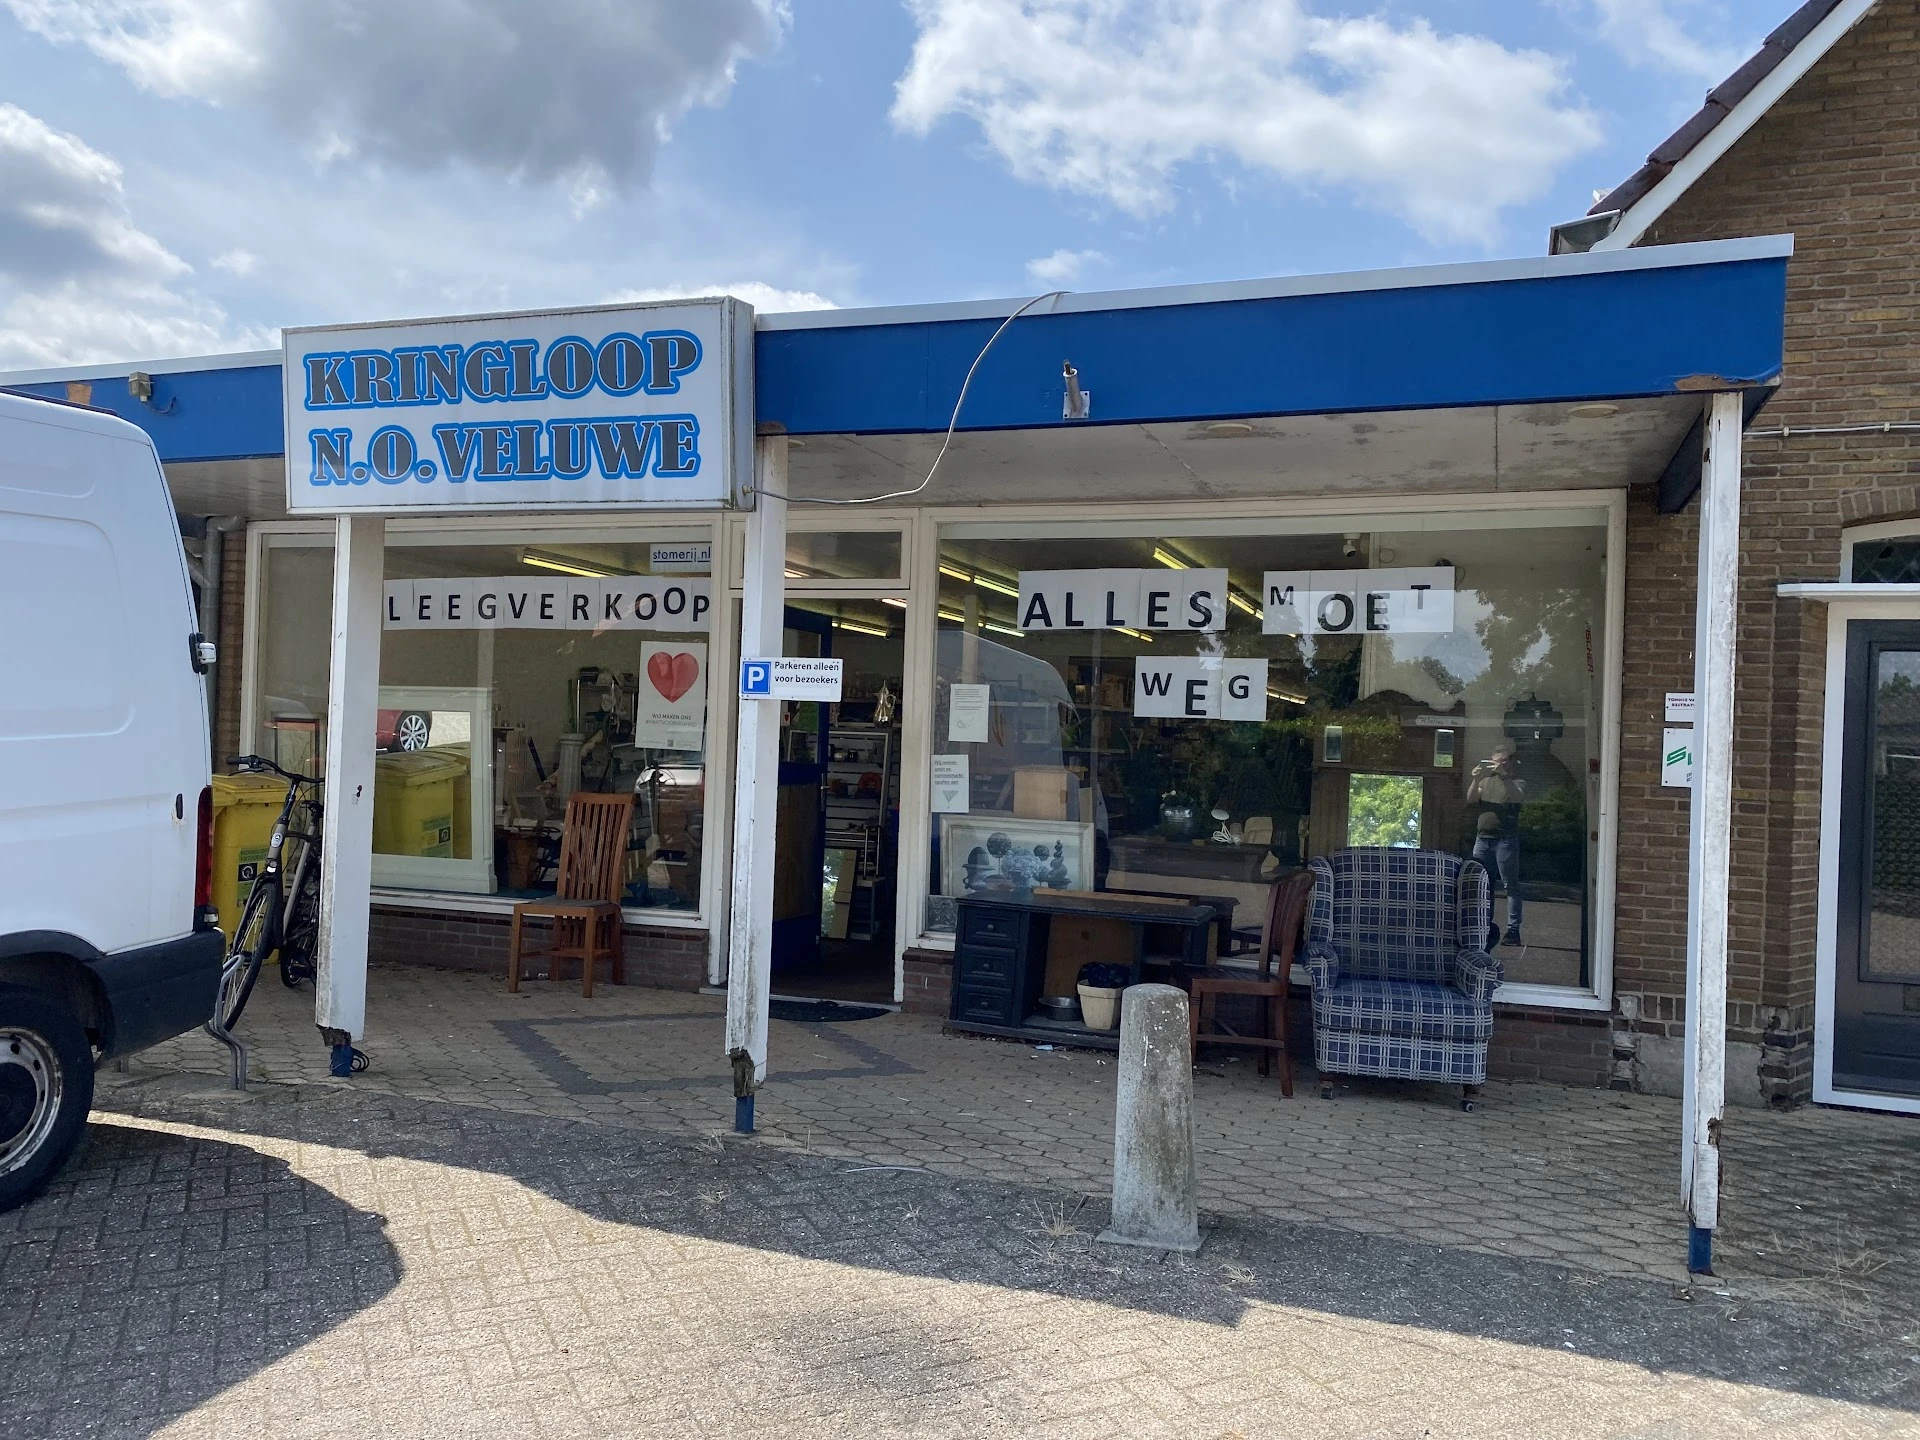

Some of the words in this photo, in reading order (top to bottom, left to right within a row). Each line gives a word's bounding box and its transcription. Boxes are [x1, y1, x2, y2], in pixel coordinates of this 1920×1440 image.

[304, 330, 702, 410] KRINGLOOP
[653, 546, 711, 563] stomerij.nl
[388, 587, 710, 623] LEEGVERKOOP
[1022, 590, 1213, 629] ALLES
[1269, 584, 1432, 632] MOET
[747, 666, 765, 690] P
[774, 661, 812, 670] Parkeren
[813, 661, 839, 671] alleen
[795, 674, 838, 684] bezoekers
[1141, 672, 1250, 717] WEG
